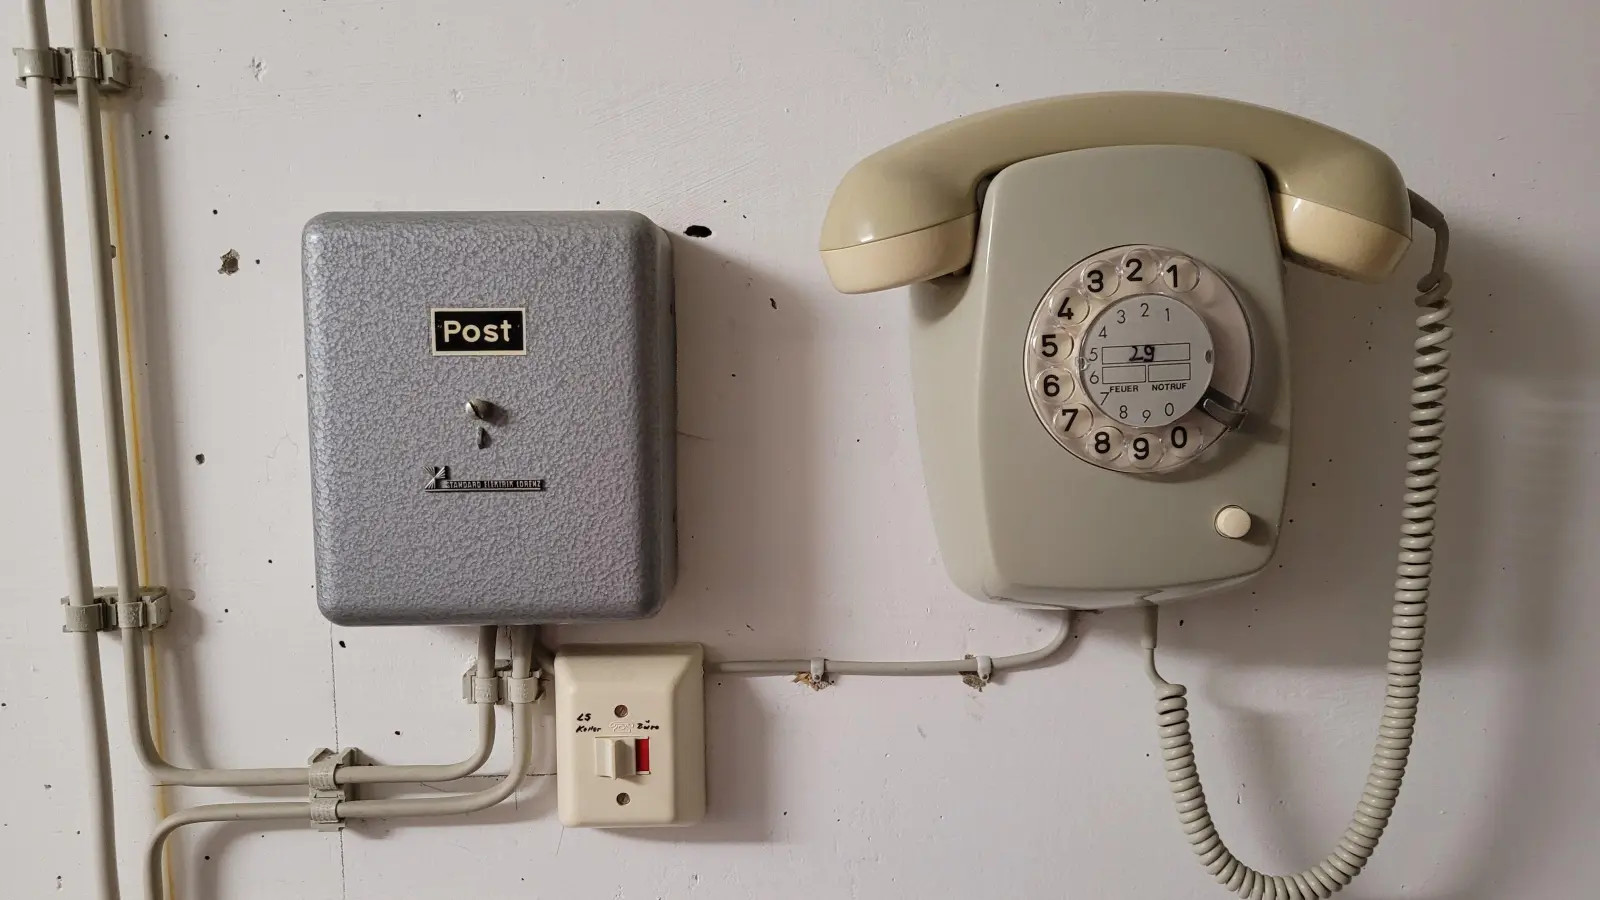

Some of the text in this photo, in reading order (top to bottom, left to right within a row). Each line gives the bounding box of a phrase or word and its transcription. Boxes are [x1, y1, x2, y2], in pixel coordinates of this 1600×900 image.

[1126, 258, 1143, 282] 2
[1166, 264, 1179, 288] 1
[1087, 270, 1104, 293] 3
[1057, 297, 1074, 320] 4
[1117, 309, 1126, 324] 3
[1140, 303, 1149, 317] 2
[443, 319, 512, 343] Post
[1098, 325, 1107, 338] 4
[1042, 334, 1058, 357] 5
[1128, 344, 1156, 362] 29
[1088, 347, 1098, 361] 5
[1043, 374, 1060, 397] 6
[1089, 371, 1099, 384] 6
[1109, 385, 1139, 393] FEUER
[1151, 382, 1187, 392] NOTRUF
[1100, 392, 1109, 406] 7
[1119, 405, 1128, 419] 8
[1142, 409, 1151, 423] 9
[1164, 402, 1174, 417] 0
[1062, 408, 1079, 432] 7
[1094, 431, 1111, 454] 8
[1171, 426, 1187, 449] 0
[1133, 437, 1150, 460] 9
[446, 480, 541, 488] STANDARD ELEKTRIK LORENZ
